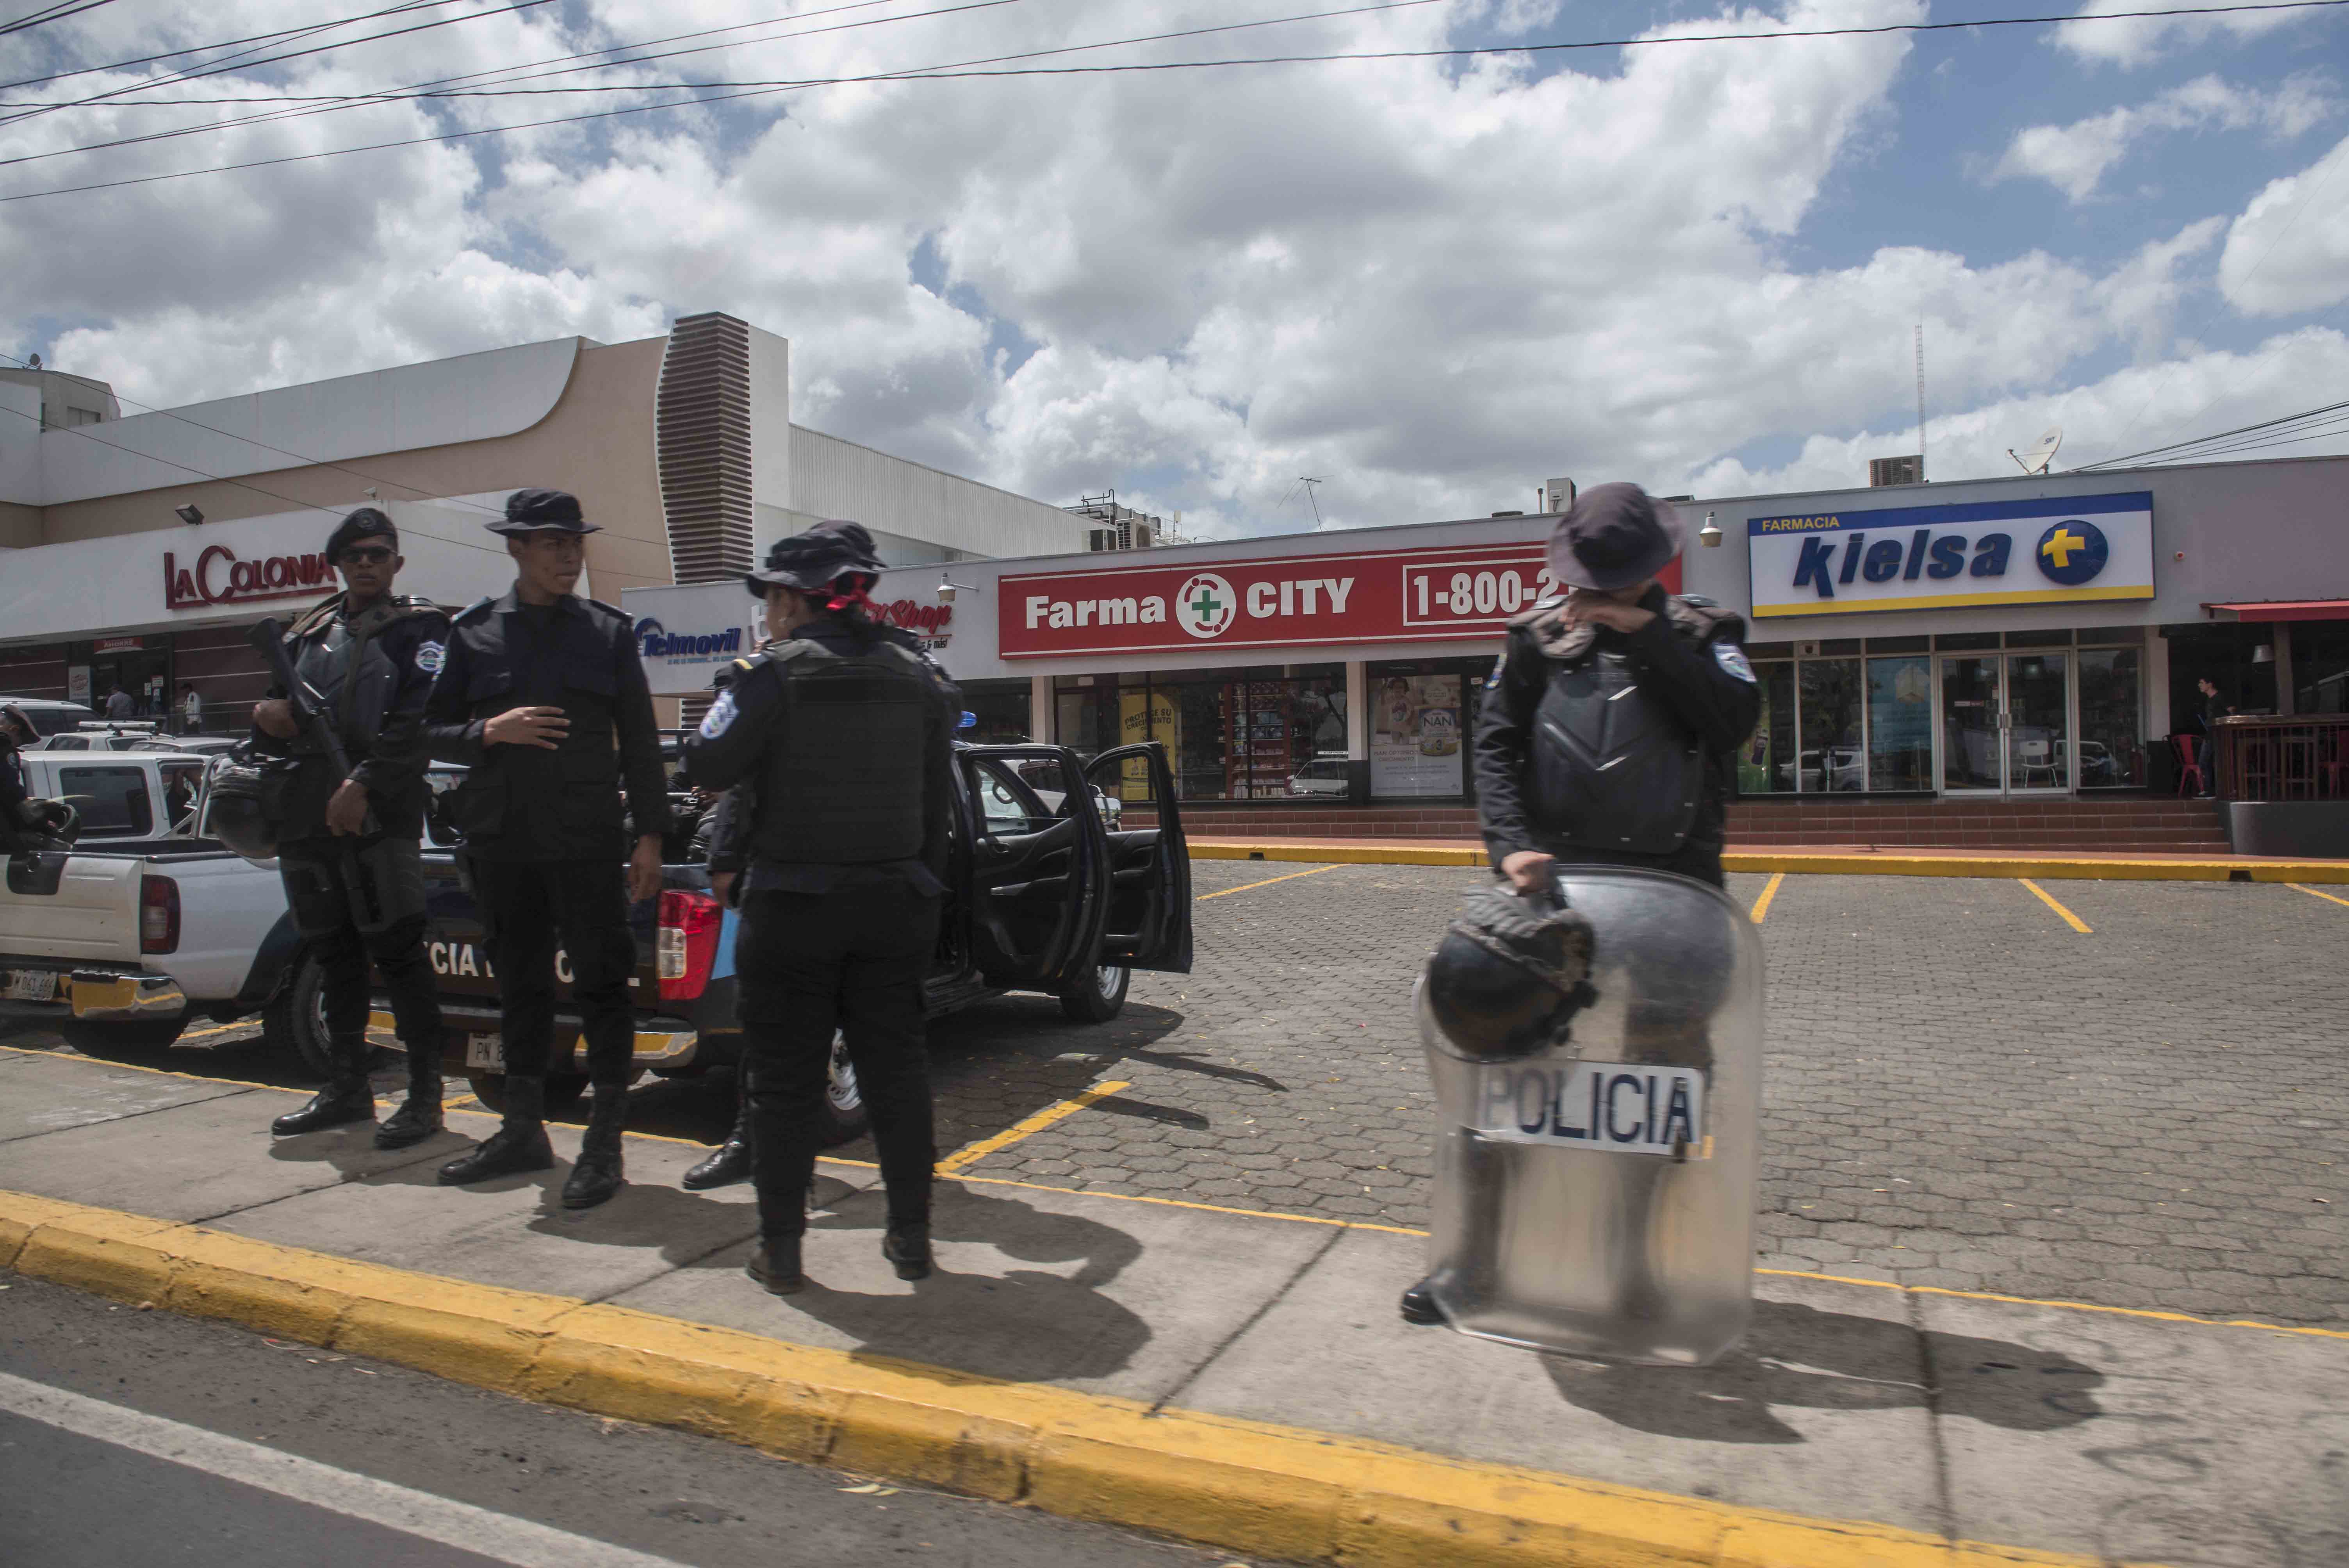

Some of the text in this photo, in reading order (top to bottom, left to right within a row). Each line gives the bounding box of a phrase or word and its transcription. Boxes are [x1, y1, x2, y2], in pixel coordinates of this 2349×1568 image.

[1762, 516, 1840, 531] FARMACIA
[1026, 577, 1355, 629] Farma CITY
[1424, 716, 1452, 726] NAN
[1485, 1069, 1692, 1145] POLICIA
